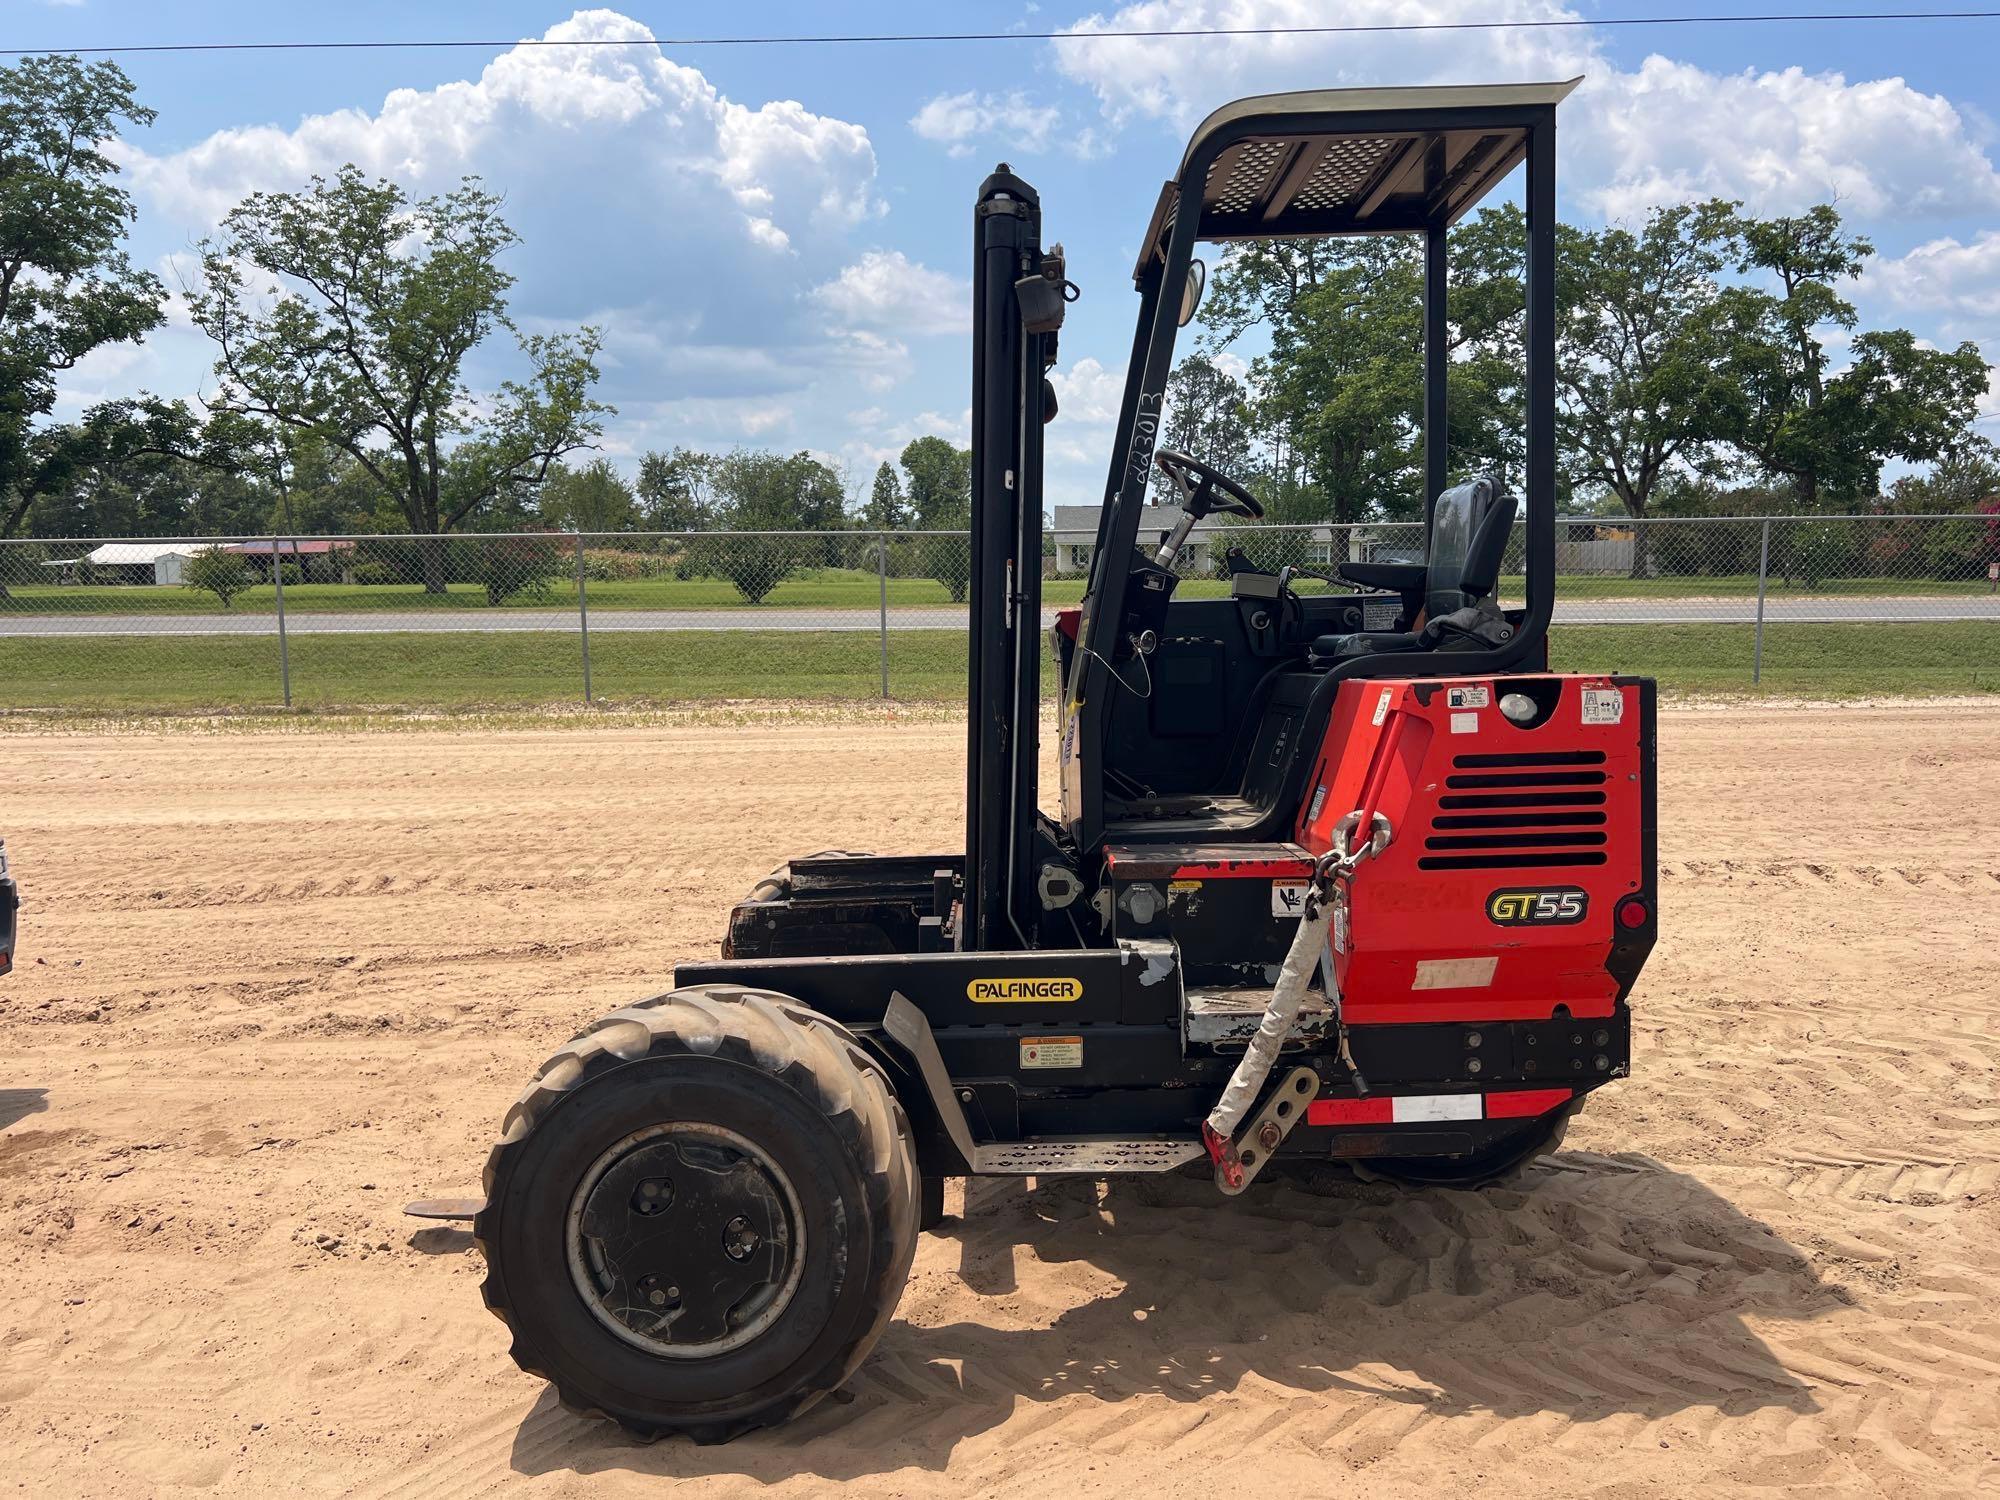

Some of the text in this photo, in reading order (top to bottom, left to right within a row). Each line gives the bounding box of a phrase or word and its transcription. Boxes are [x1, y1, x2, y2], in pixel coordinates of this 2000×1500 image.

[1129, 393, 1162, 484] 223013
[1491, 892, 1584, 919] GT55
[975, 983, 1075, 998] PALFINGER
